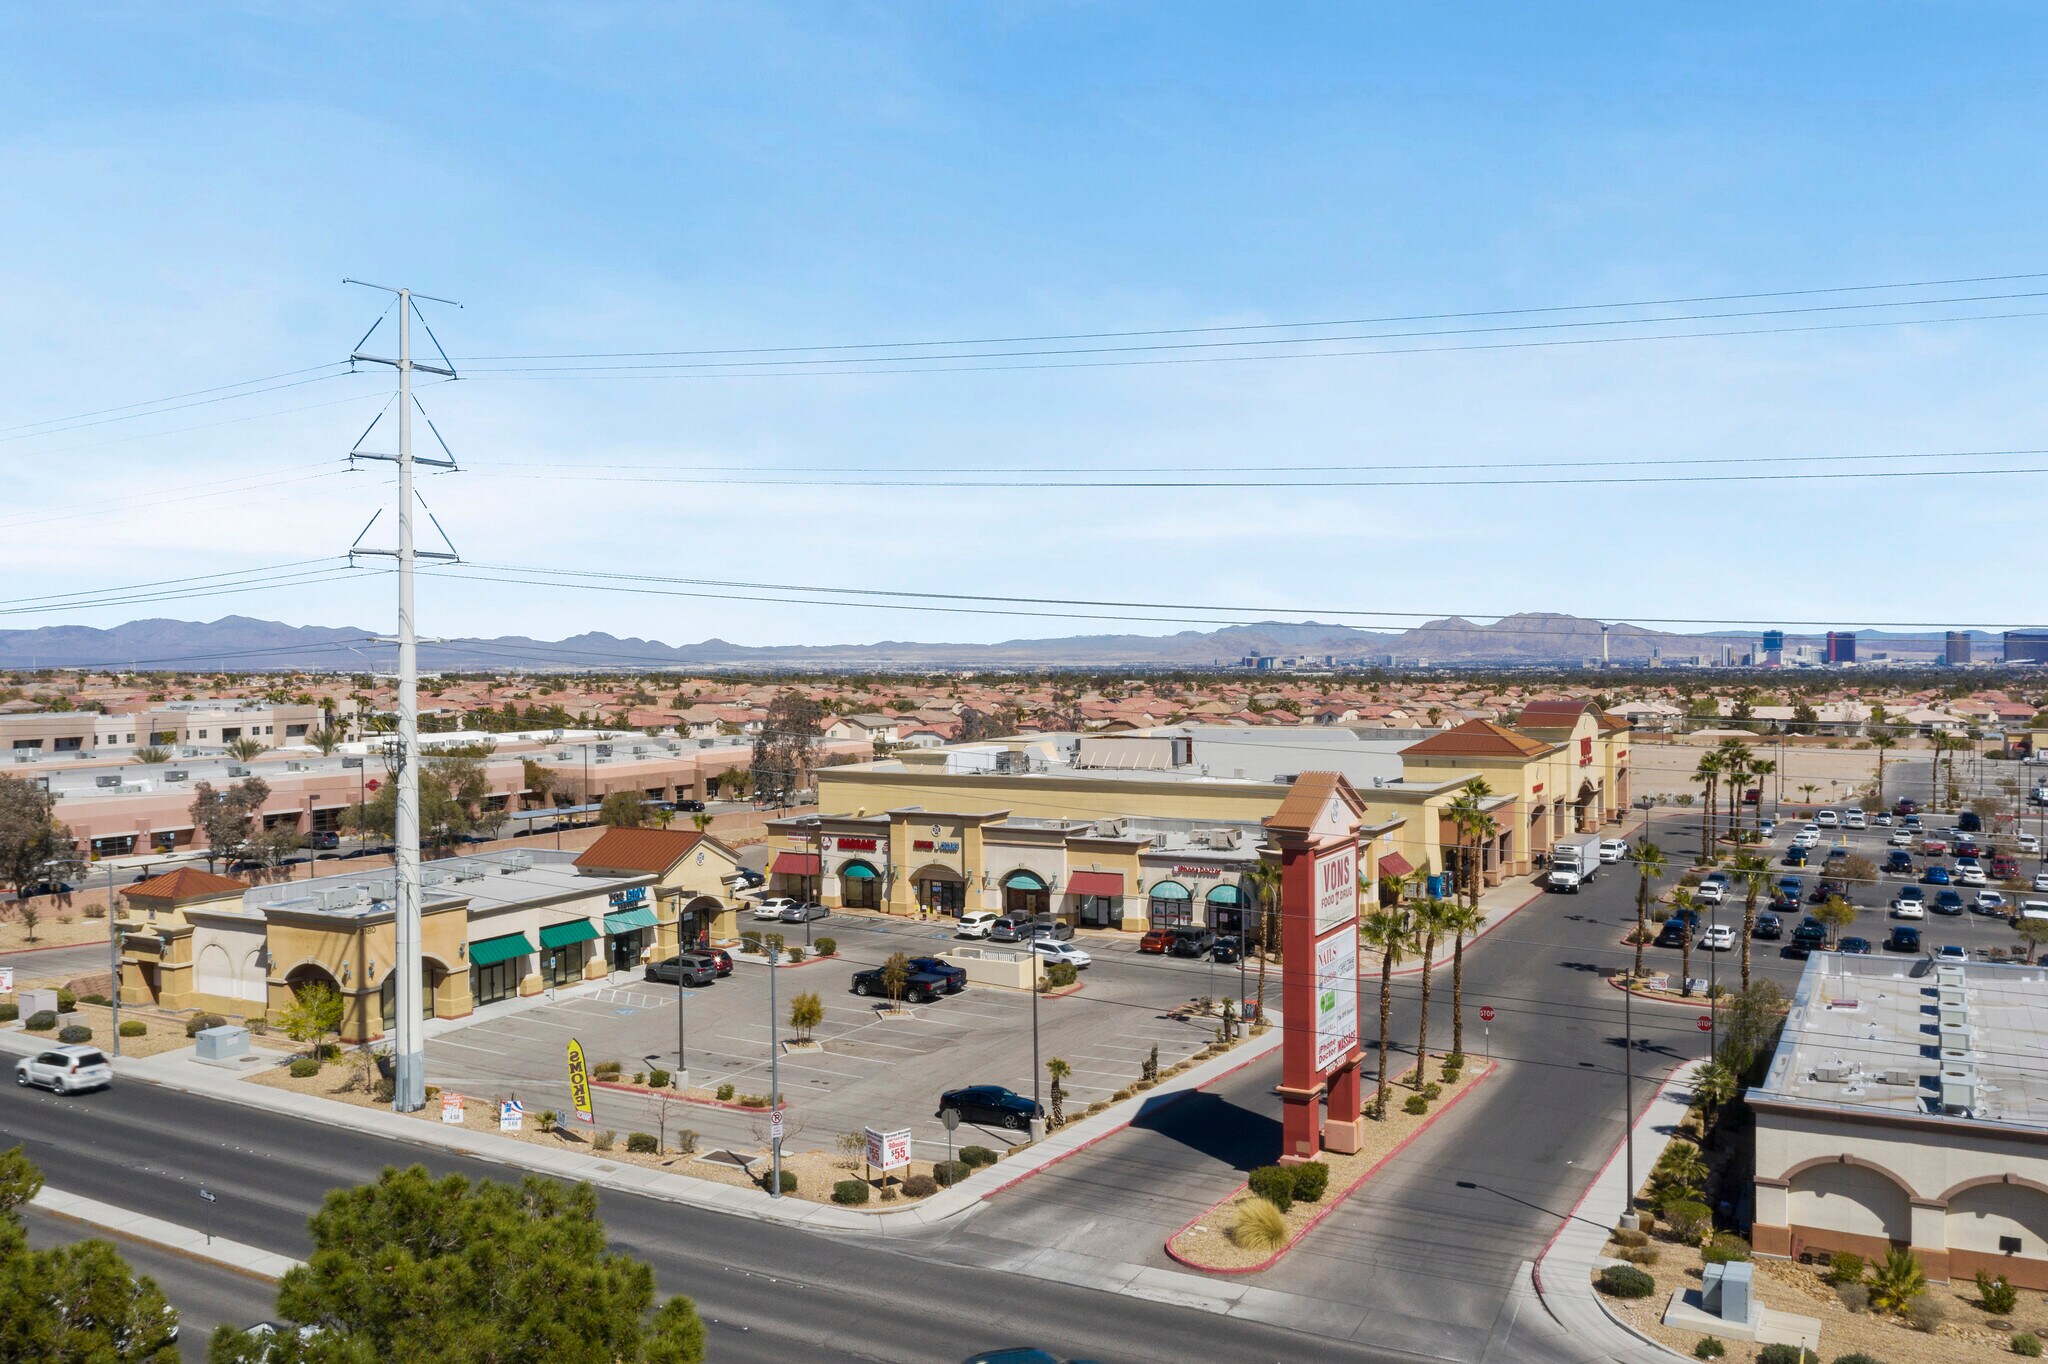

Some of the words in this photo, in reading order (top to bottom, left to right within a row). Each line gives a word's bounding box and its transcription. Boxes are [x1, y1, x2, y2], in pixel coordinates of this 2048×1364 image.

[1323, 855, 1350, 893] VONS
[626, 886, 647, 900] DMV
[1321, 894, 1335, 909] FOOD
[1340, 886, 1353, 900] DRUG
[1319, 1047, 1337, 1064] Doctor
[891, 1147, 906, 1160] $55
